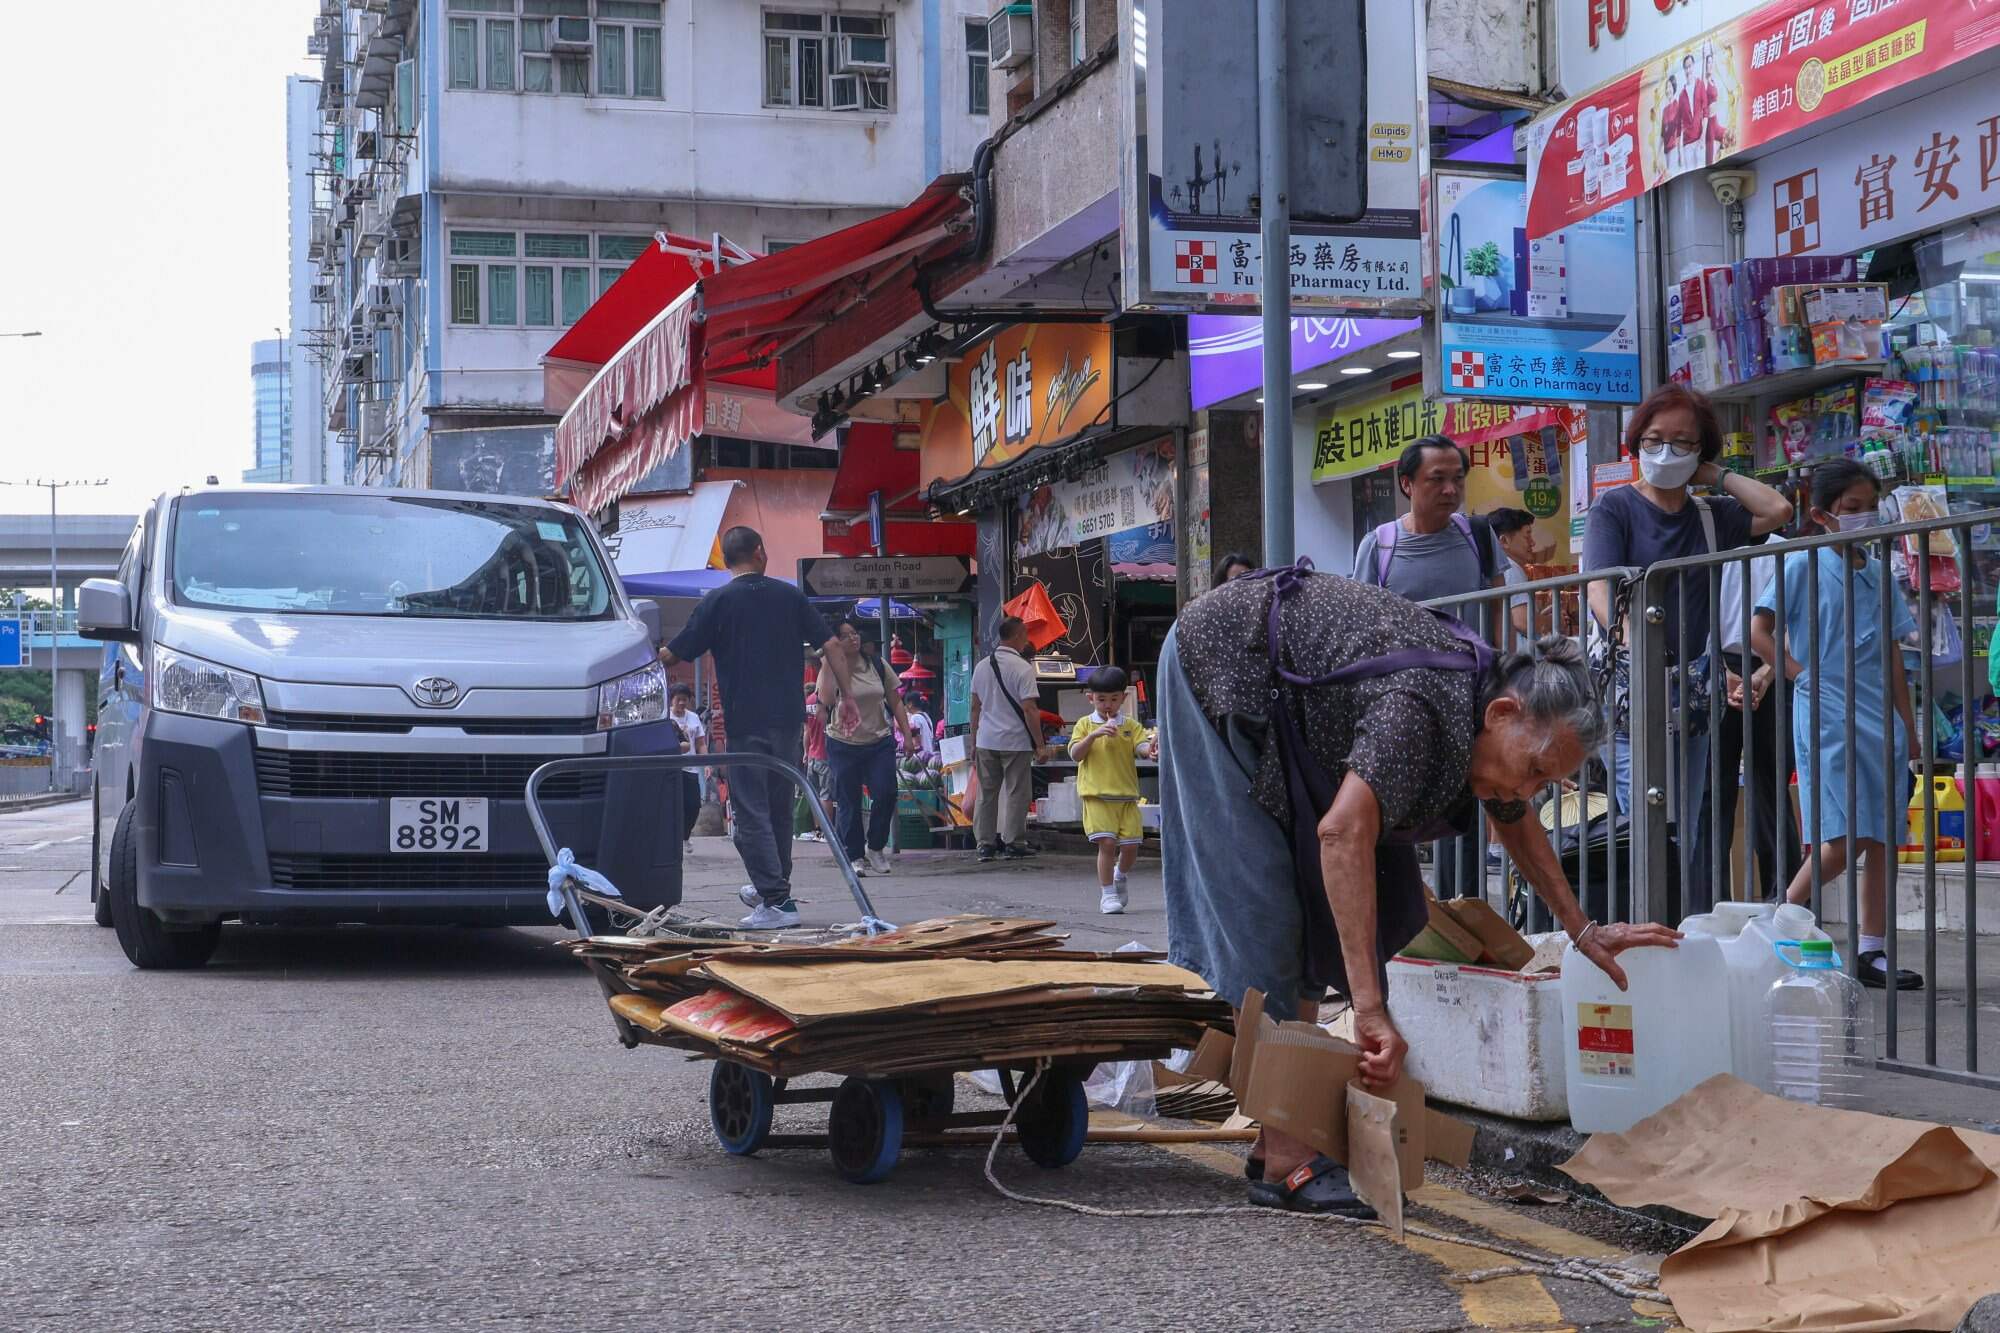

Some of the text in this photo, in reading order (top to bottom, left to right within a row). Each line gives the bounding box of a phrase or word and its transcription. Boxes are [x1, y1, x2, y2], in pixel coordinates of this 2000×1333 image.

[1828, 32, 1916, 86] 結晶型葡萄糖胺
[1752, 84, 1793, 121] 維固力
[1229, 239, 1409, 275] 富西藥房有限公司
[1233, 271, 1410, 293] Fu Pharmacy Ltd.
[1487, 375, 1635, 393] Fu On Pharmacy Ltd.
[970, 340, 1032, 467] 鮮味
[1082, 512, 1115, 535] 6651 5703
[853, 561, 921, 573] Canton Road
[419, 800, 460, 825] SM
[396, 825, 481, 850] 8892
